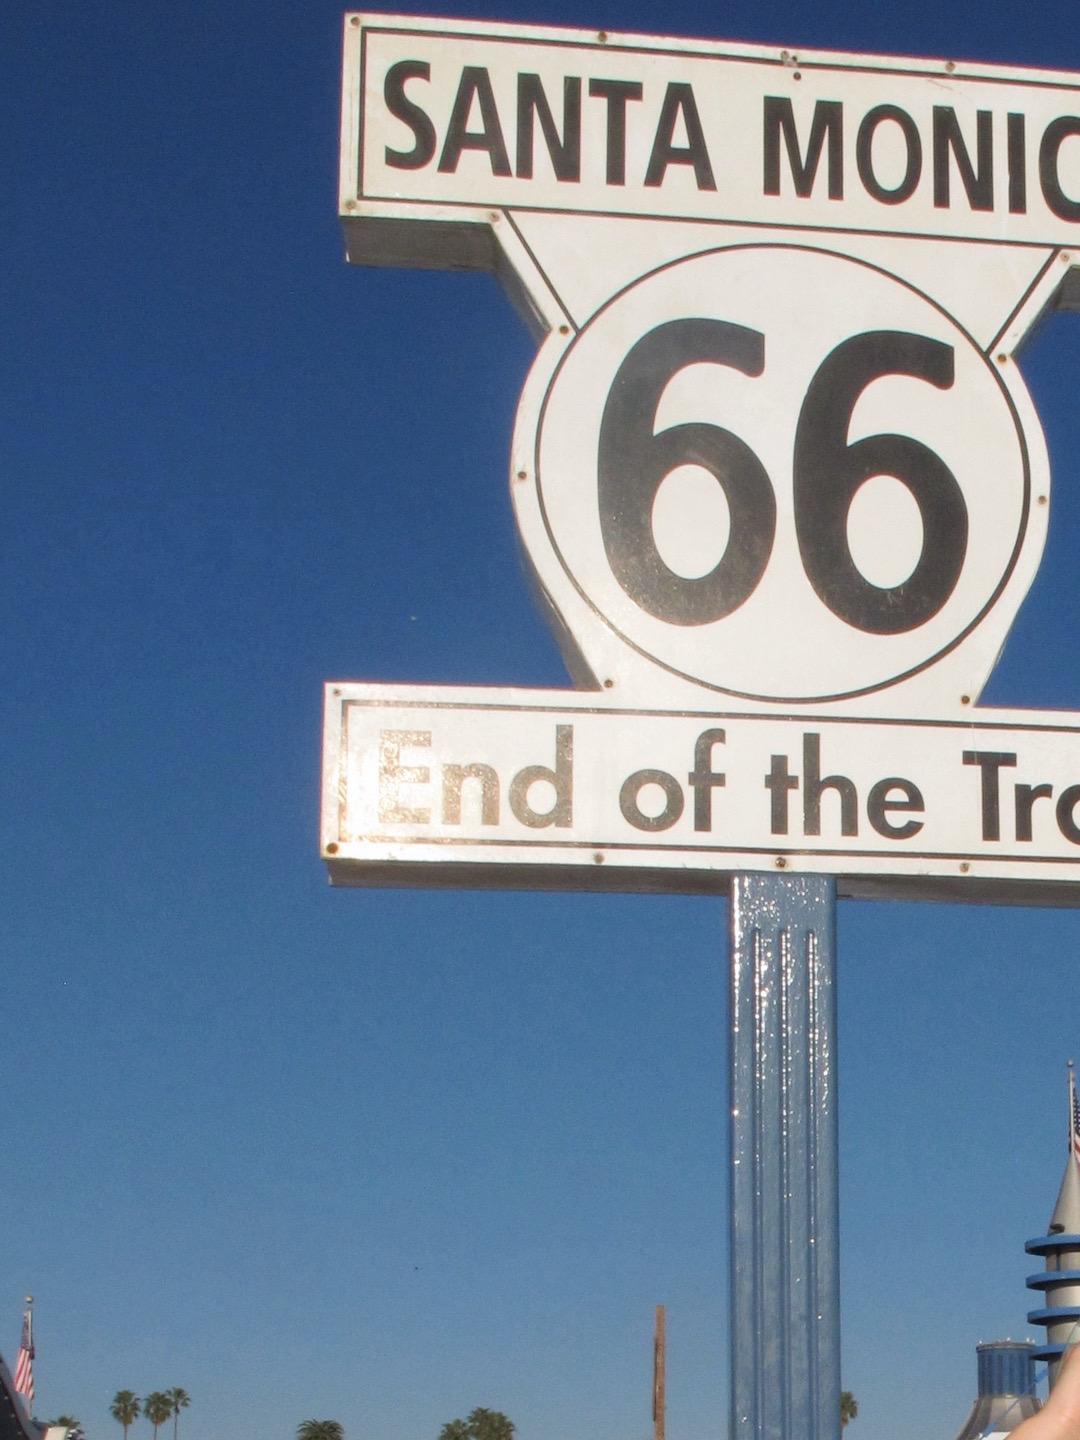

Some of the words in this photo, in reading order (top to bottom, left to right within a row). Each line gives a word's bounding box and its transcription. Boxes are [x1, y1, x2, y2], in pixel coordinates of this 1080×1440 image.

[383, 60, 717, 192] SANTA
[597, 317, 969, 636] 66
[376, 724, 574, 829] End
[618, 728, 727, 833] of
[764, 733, 926, 840] the
